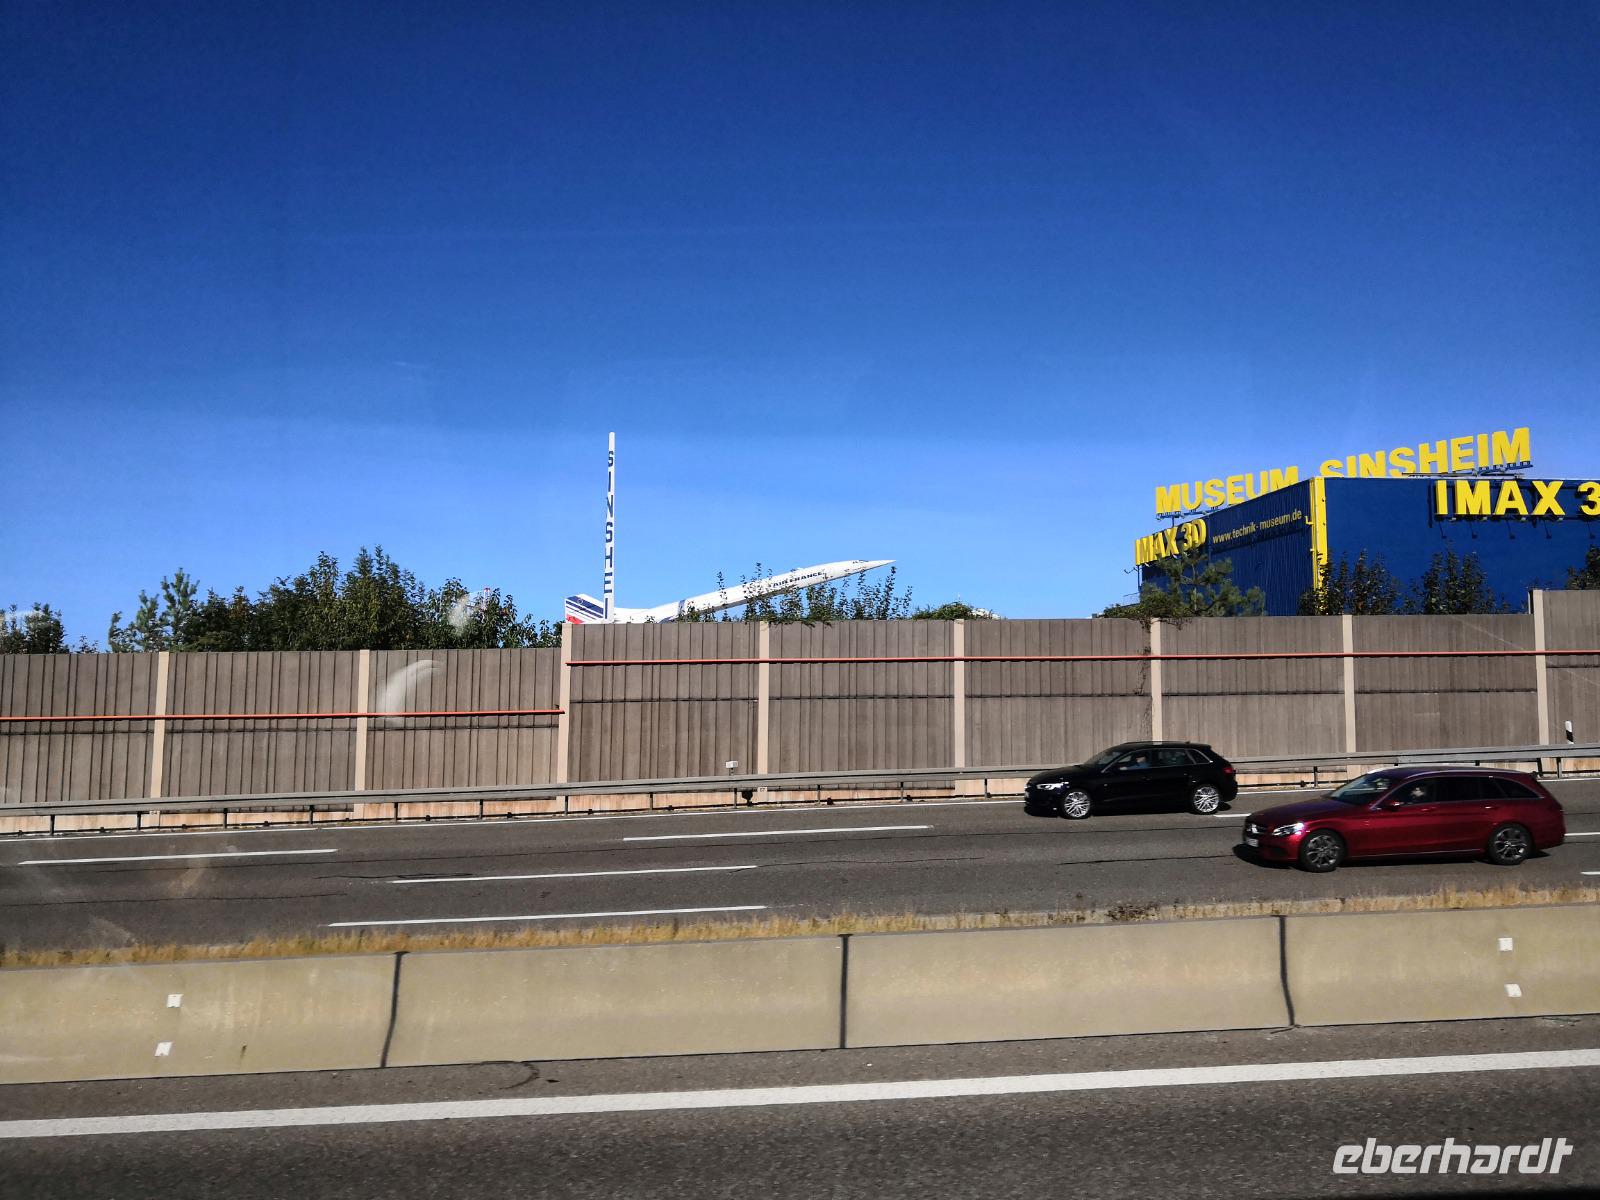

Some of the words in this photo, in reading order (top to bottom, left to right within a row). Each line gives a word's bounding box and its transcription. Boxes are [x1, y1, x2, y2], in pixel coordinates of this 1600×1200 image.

[1155, 465, 1299, 514] MUSEUM
[1319, 427, 1531, 478] SINSHEIM
[1435, 480, 1566, 516] IMAX
[1135, 527, 1180, 566] IMAX
[1180, 518, 1207, 552] 3D
